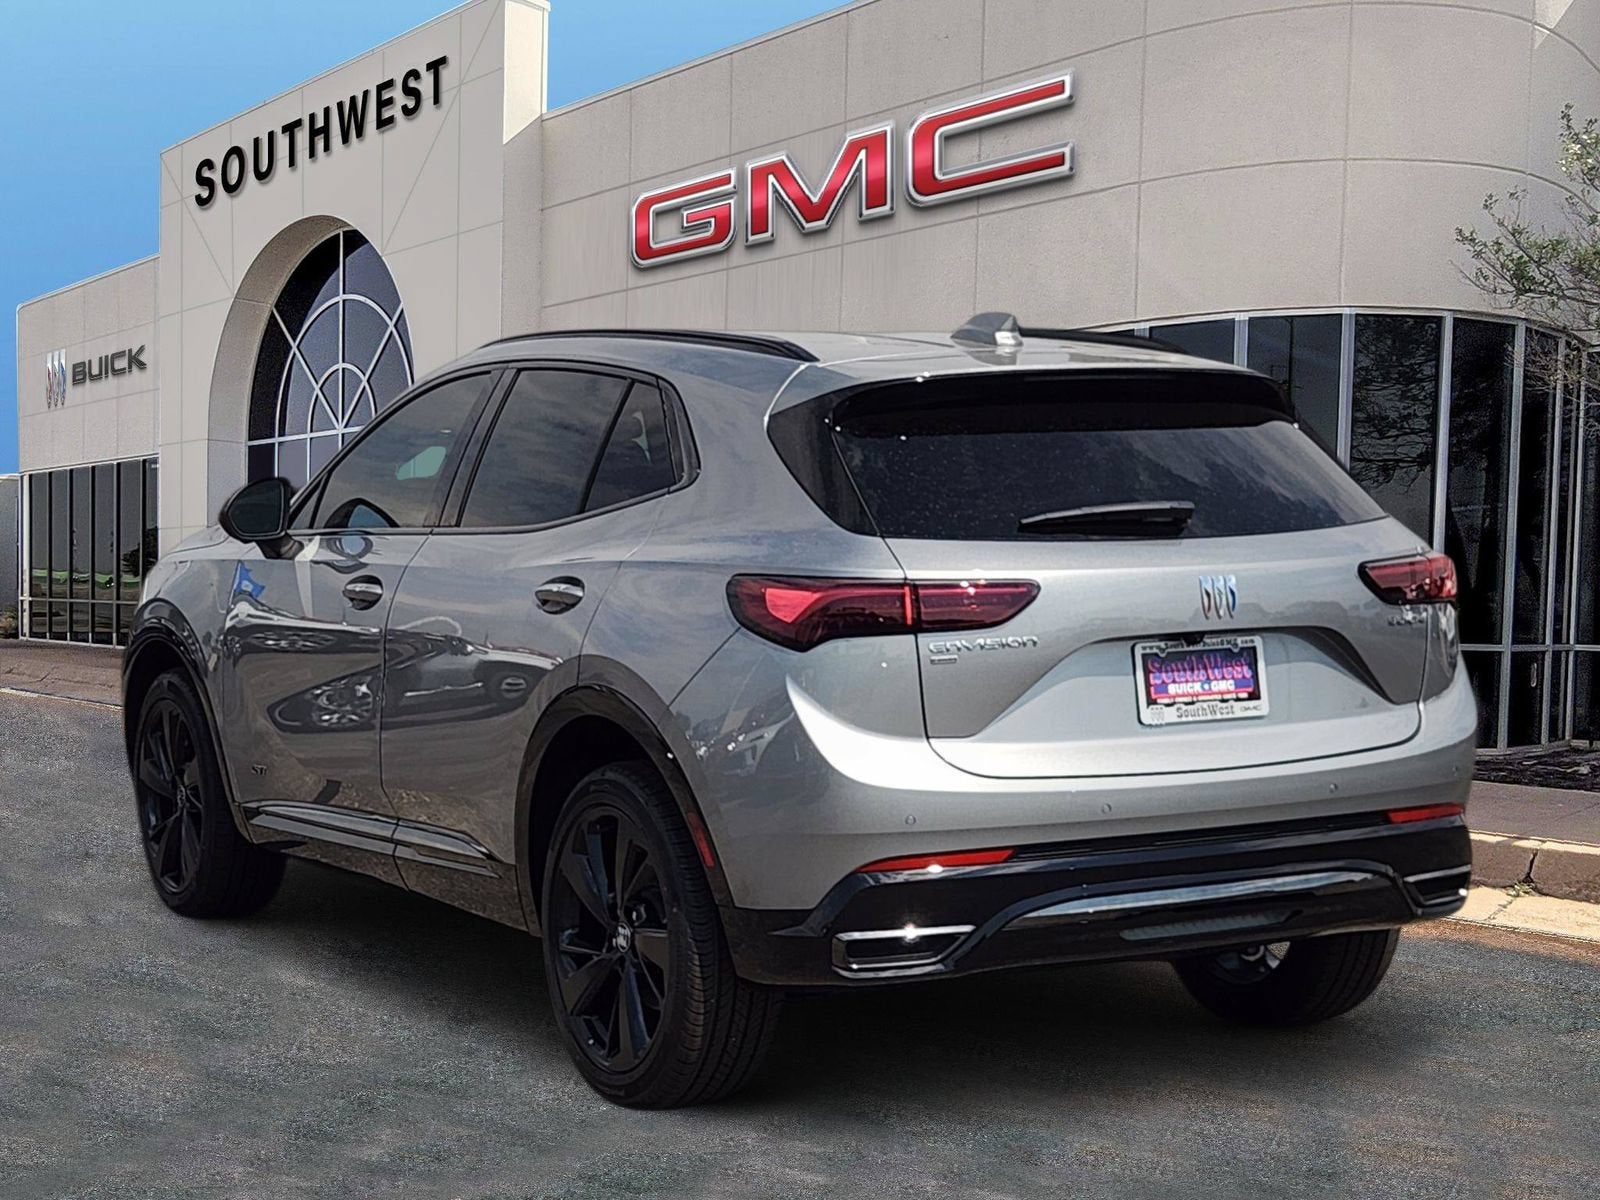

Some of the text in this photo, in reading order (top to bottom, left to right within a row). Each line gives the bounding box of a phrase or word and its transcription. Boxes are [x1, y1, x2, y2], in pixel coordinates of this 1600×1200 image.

[195, 55, 448, 207] SOUTHWEST
[631, 69, 1075, 268] GMC
[72, 344, 147, 385] BUICK
[1167, 679, 1235, 694] BUICK GMC
